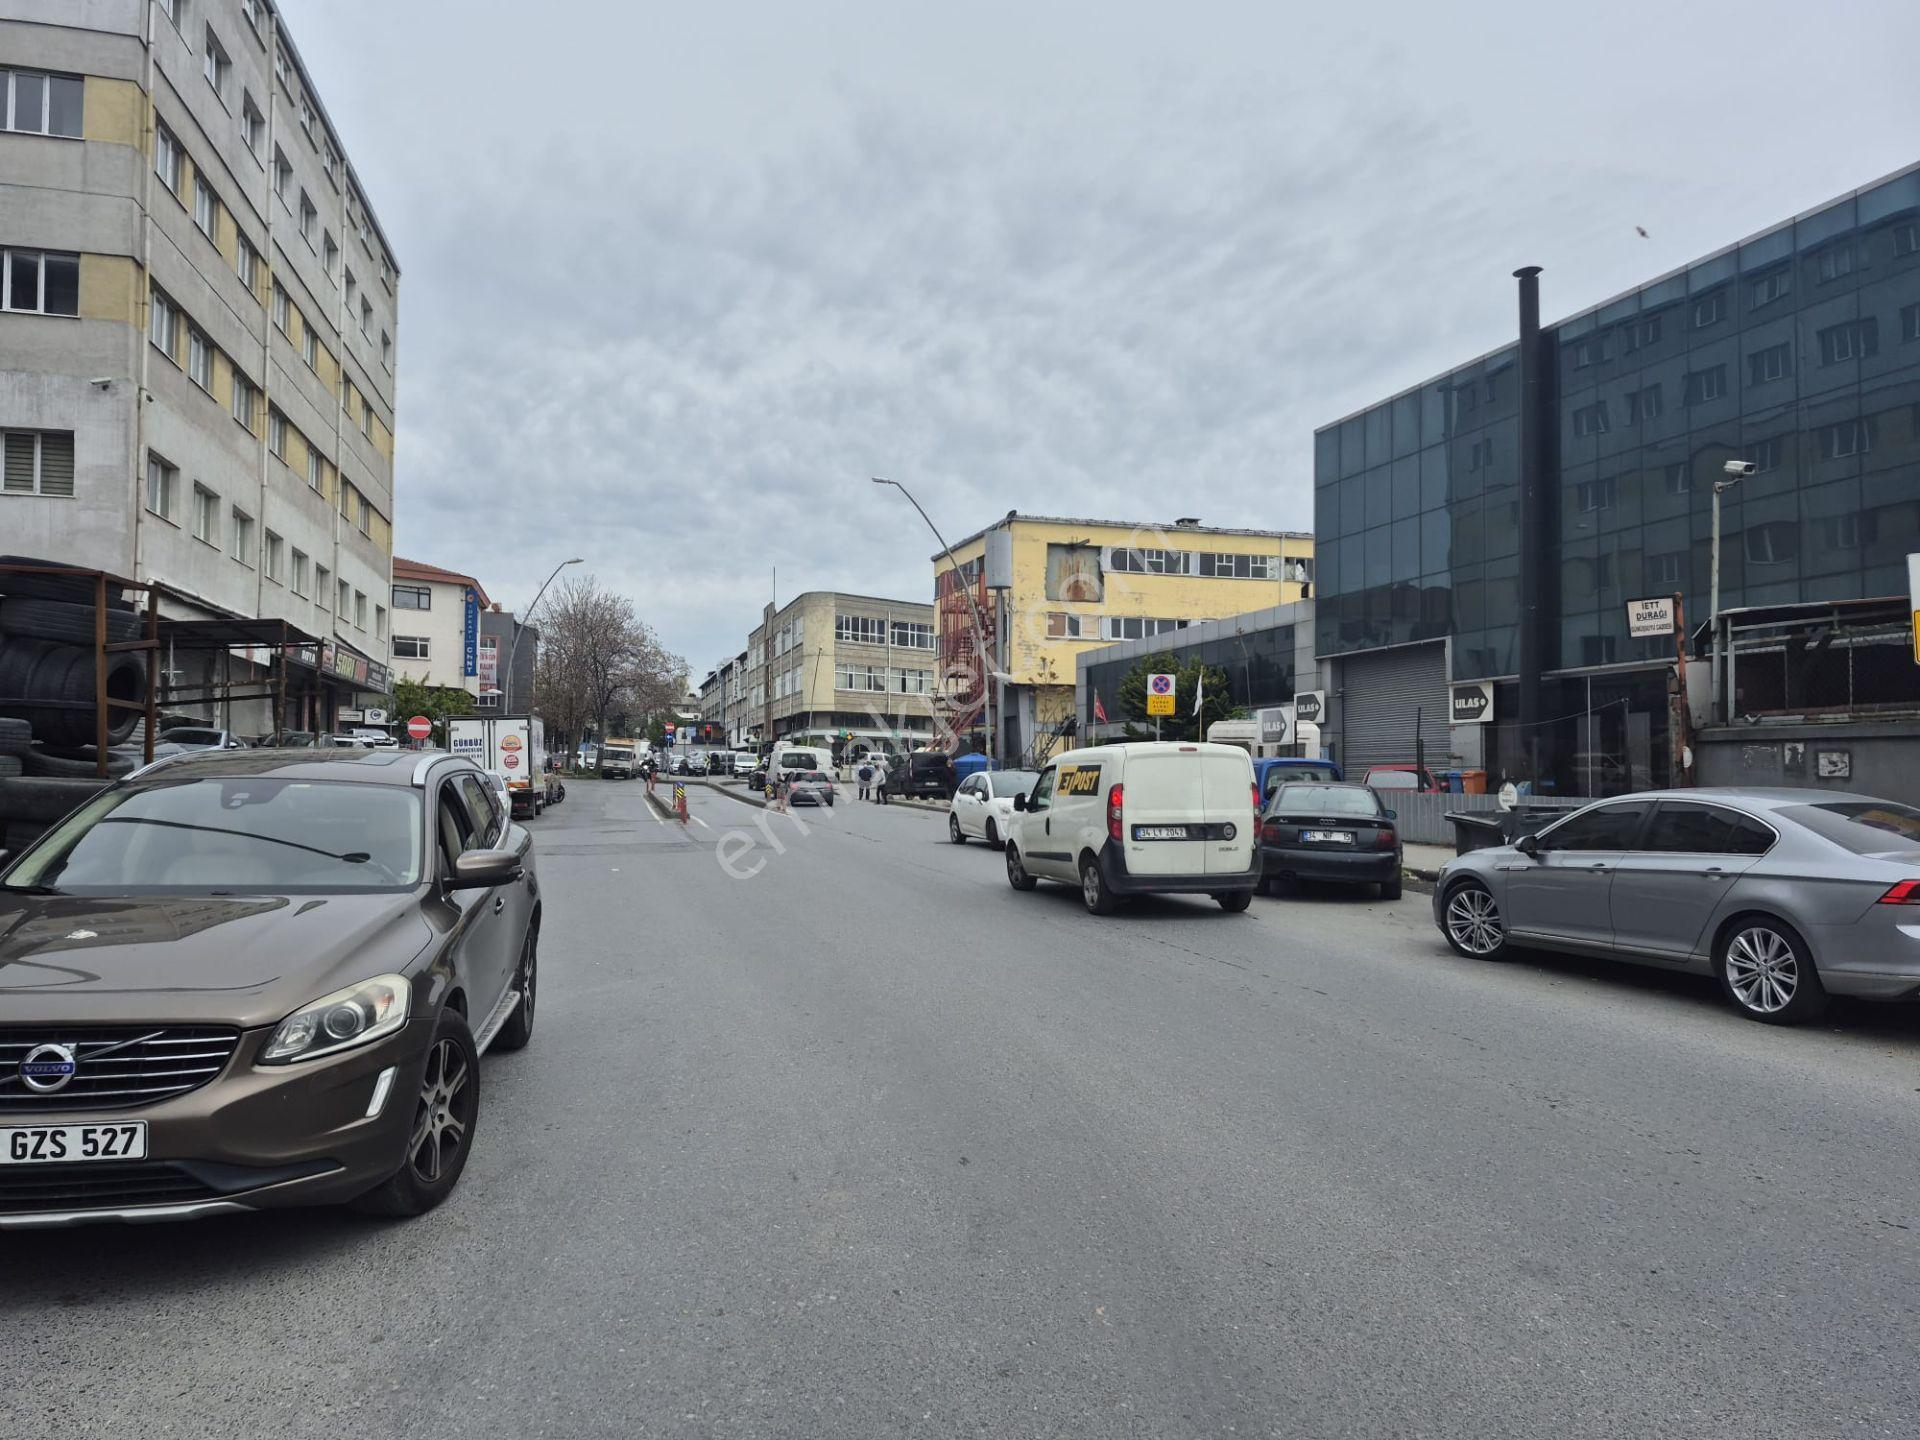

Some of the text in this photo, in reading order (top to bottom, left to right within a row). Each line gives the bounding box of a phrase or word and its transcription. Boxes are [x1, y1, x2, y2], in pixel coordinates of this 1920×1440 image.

[1166, 827, 1184, 836] 2042
[25, 1063, 71, 1073] VOLVO
[10, 1127, 138, 1160] GZS 527
